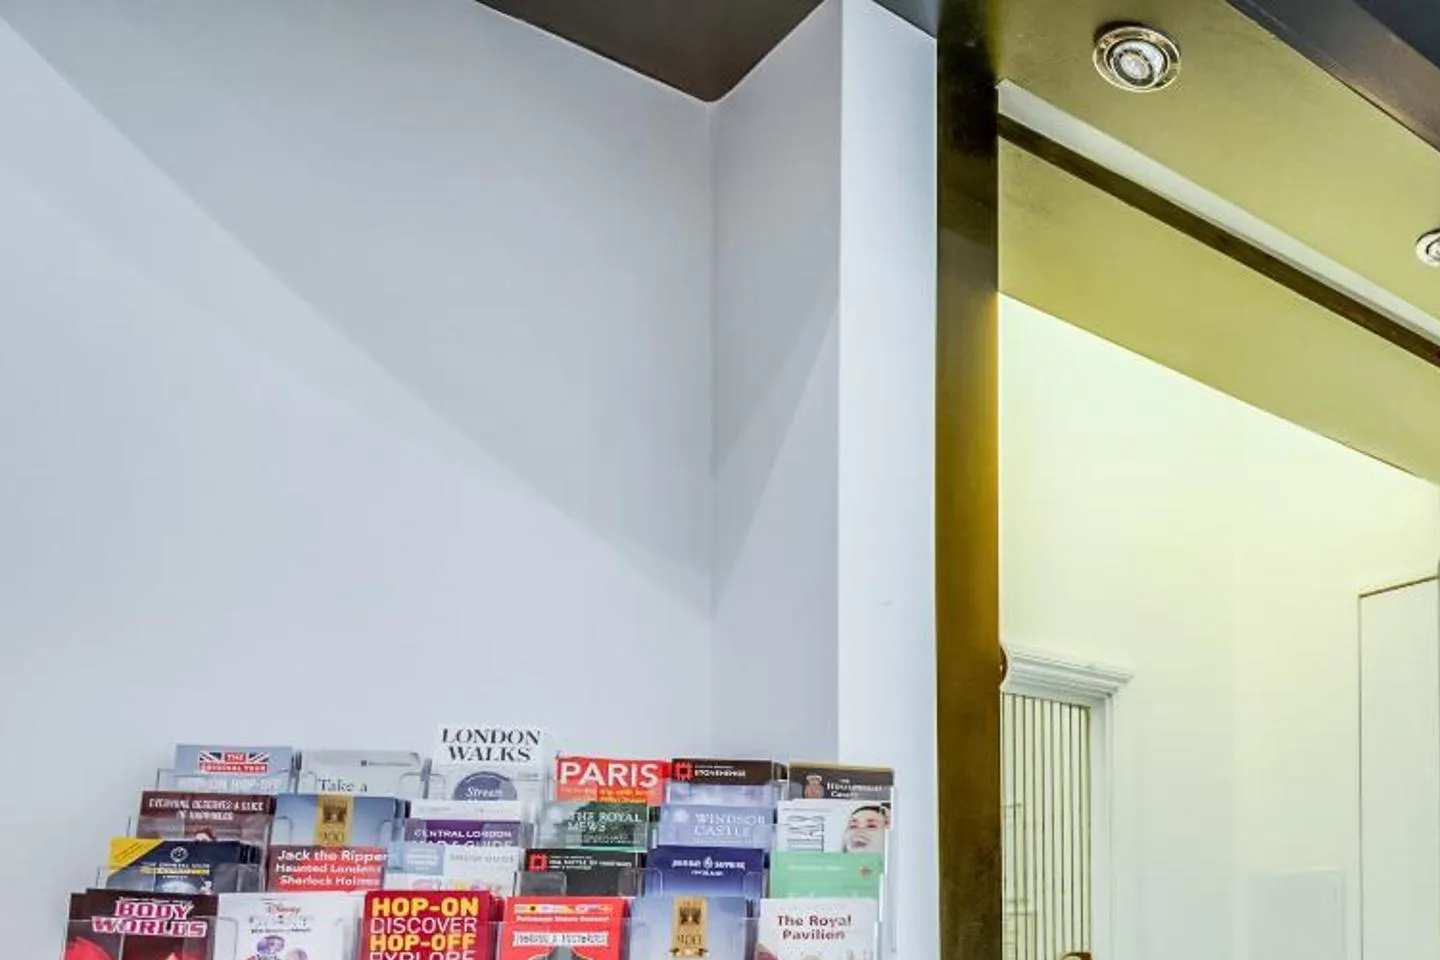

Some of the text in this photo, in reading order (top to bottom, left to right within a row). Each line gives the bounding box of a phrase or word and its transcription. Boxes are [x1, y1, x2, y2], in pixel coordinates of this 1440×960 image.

[442, 727, 541, 745] LONDON
[449, 746, 532, 762] WALKS
[560, 761, 659, 788] PARIS
[318, 779, 354, 792] Take
[601, 812, 642, 823] ROYAL
[694, 813, 766, 825] WINDSOR
[414, 829, 513, 838] CENTRAL LONDON
[567, 822, 607, 832] MEWS
[693, 825, 750, 837] CASTLE
[277, 850, 389, 864] Jack the Ripper
[276, 863, 328, 873] Haunted
[279, 875, 380, 886] Sherlock Holmes
[115, 900, 195, 920] BODY
[371, 897, 479, 917] HOP-ON
[92, 916, 208, 938] WORLDS
[369, 916, 477, 934] DISCOVER
[777, 914, 852, 930] The Royal
[781, 928, 846, 940] Pavilion
[369, 934, 476, 952] HOP-OFF
